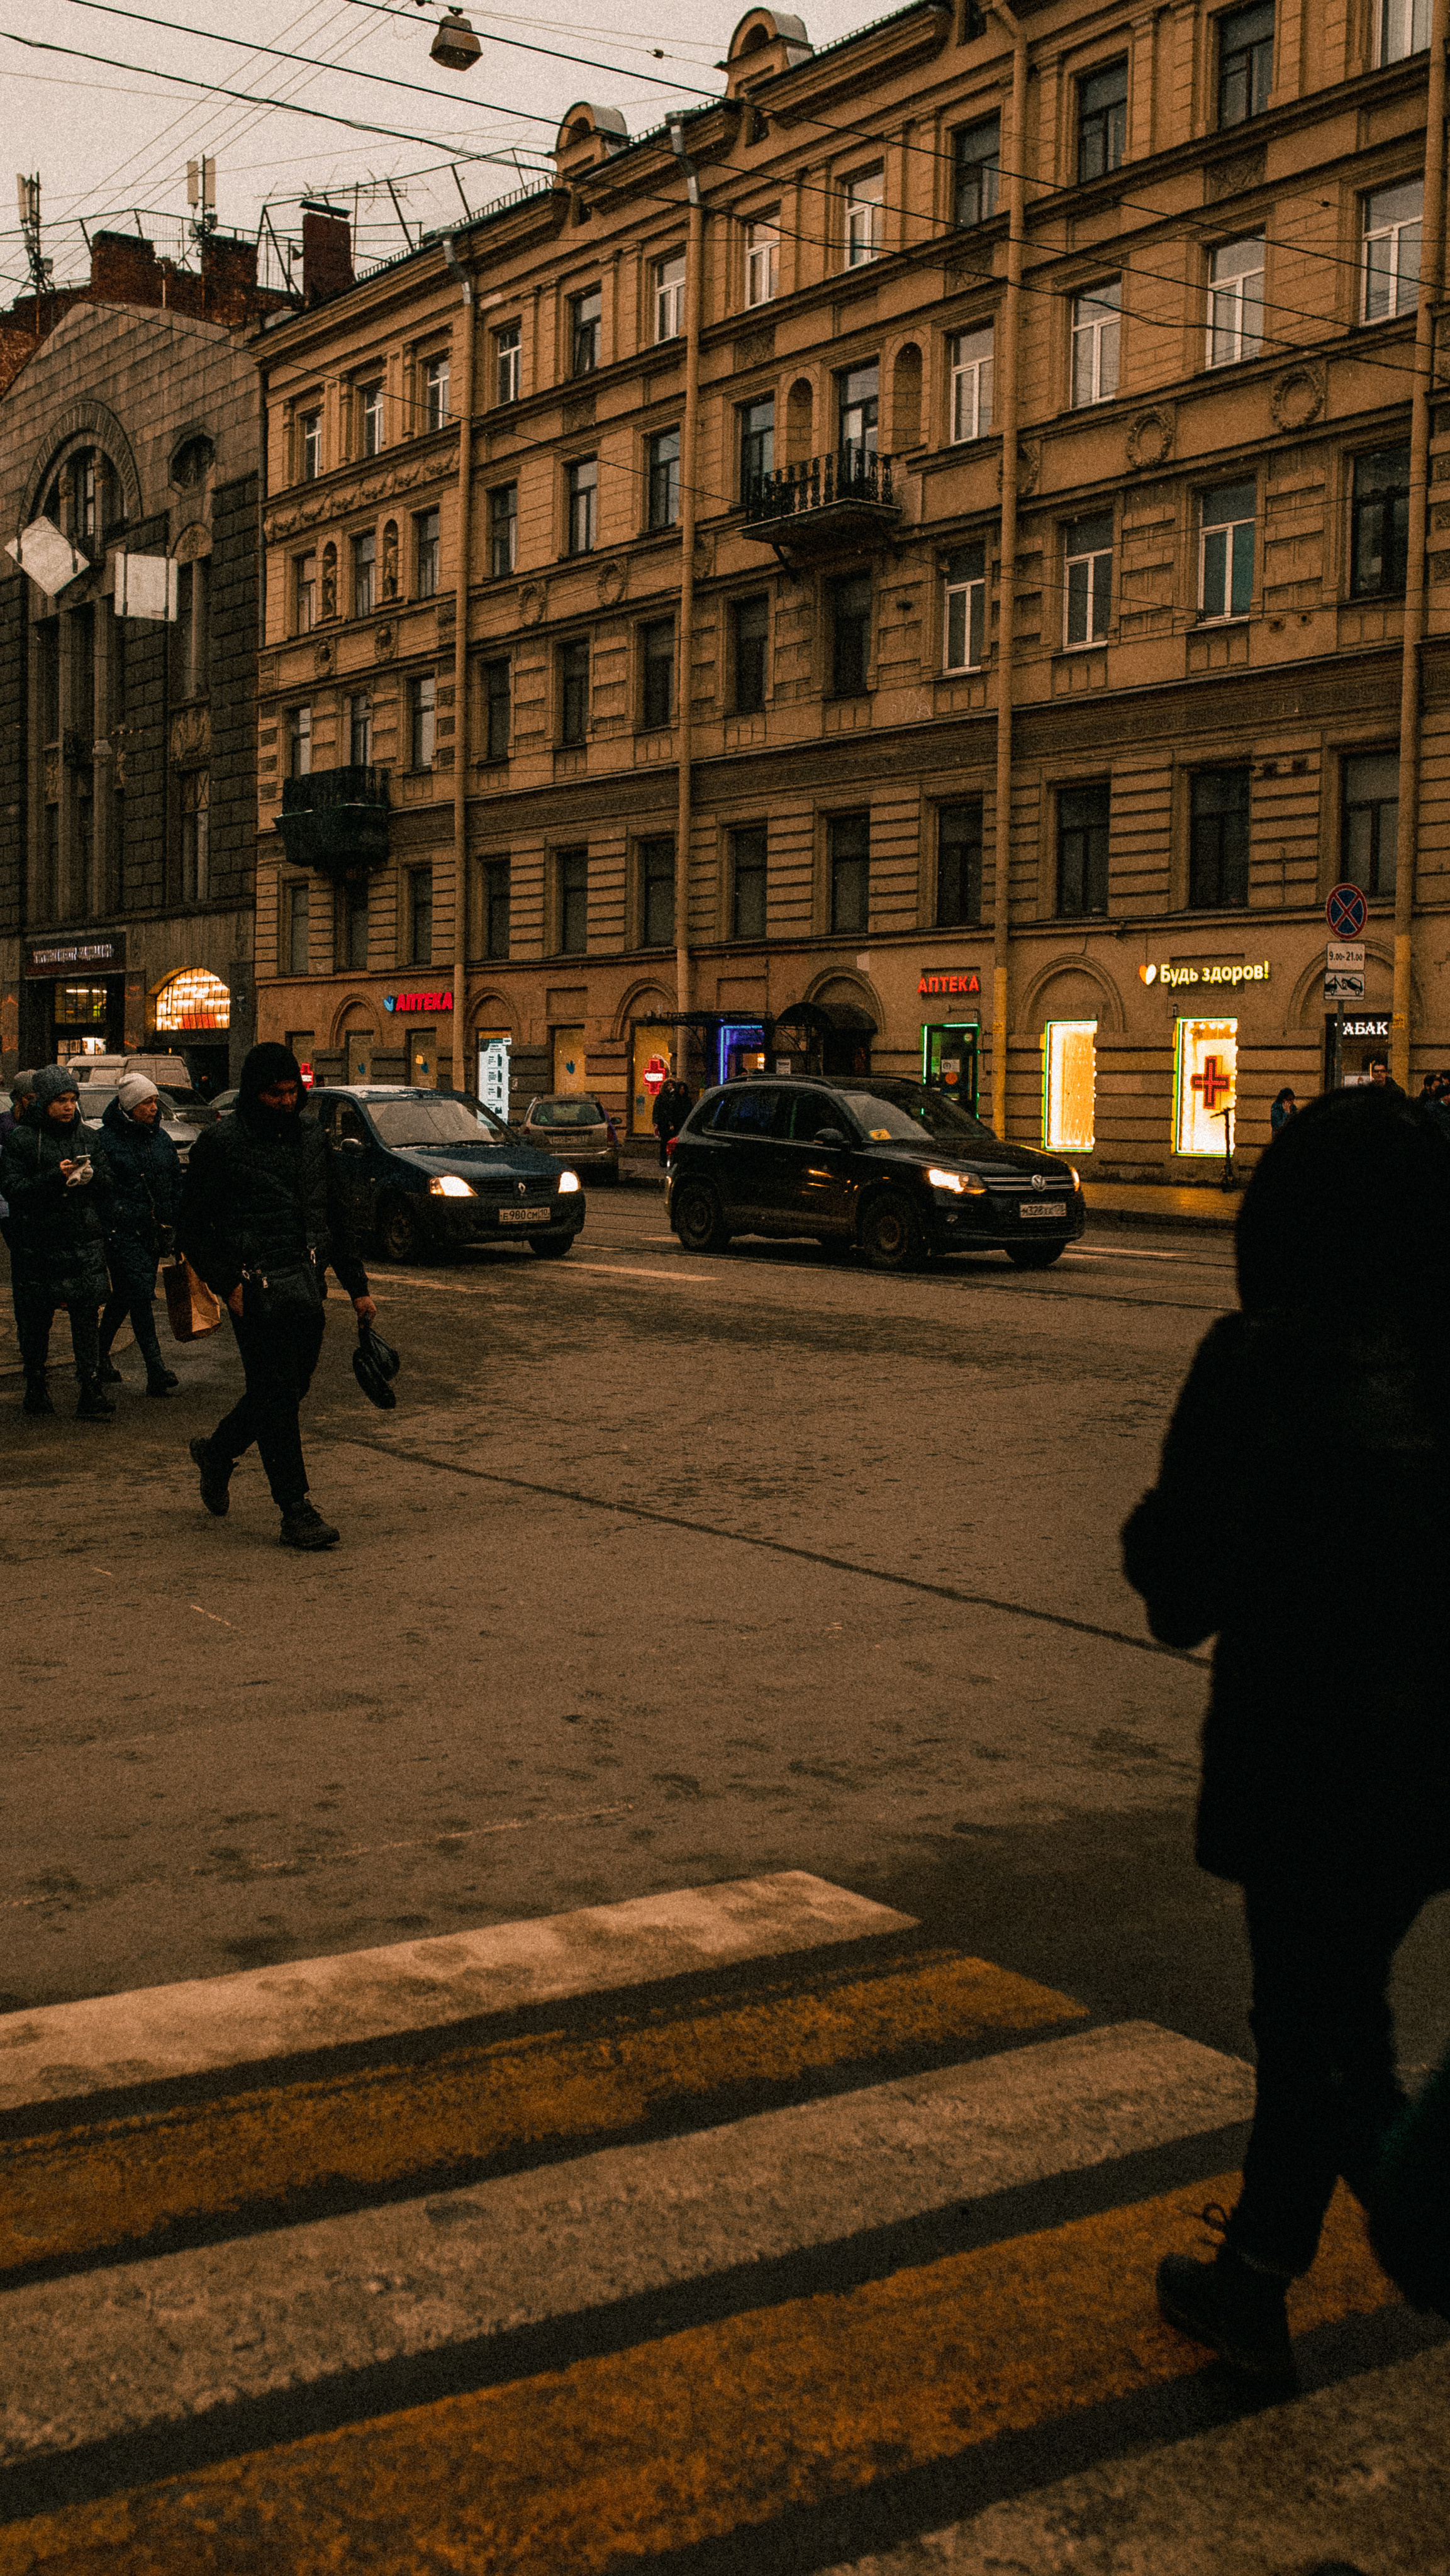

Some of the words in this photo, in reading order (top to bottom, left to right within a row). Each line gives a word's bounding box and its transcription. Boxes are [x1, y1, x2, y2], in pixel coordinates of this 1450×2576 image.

[1346, 951, 1363, 961] 21.00
[1160, 963, 1198, 987] Будь
[1202, 960, 1269, 985] здоров!
[917, 975, 979, 994] АПТЕКА
[395, 992, 453, 1011] АПТЕКА
[1334, 1022, 1388, 1035] АБАК
